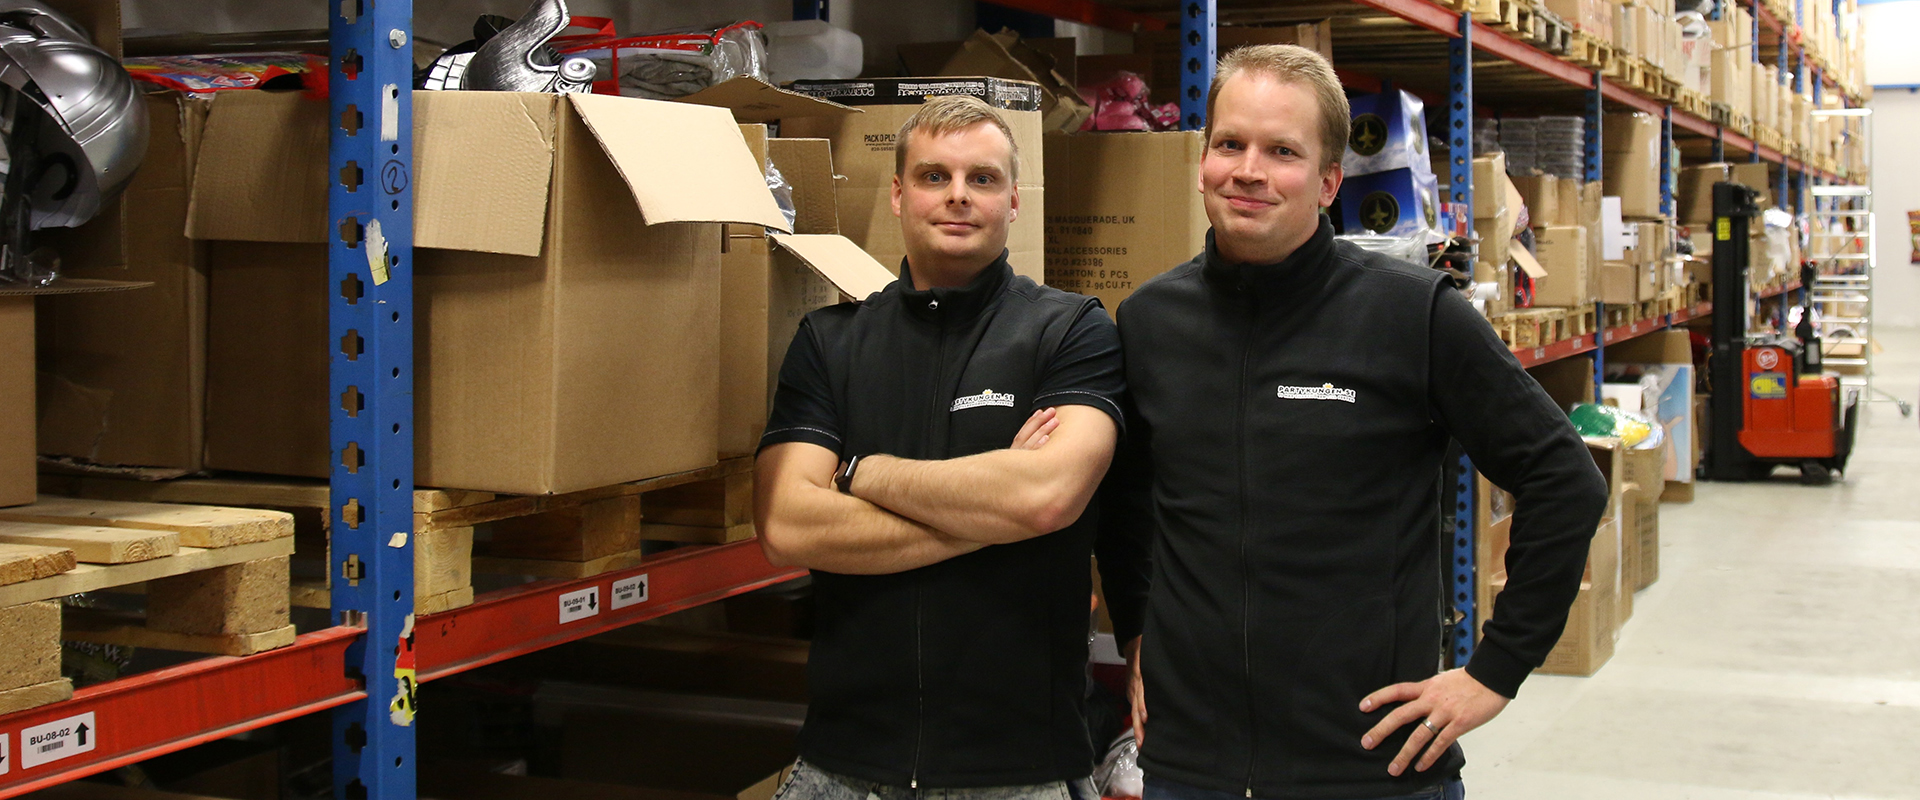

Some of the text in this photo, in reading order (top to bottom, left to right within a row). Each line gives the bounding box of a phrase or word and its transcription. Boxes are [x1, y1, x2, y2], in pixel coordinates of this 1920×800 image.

[864, 134, 879, 142] PACK
[1122, 216, 1135, 224] UK
[1064, 247, 1127, 255] ACCESSORIES
[1099, 270, 1105, 279] 6
[1110, 271, 1128, 279] PCS
[29, 728, 70, 746] BU-08-02
